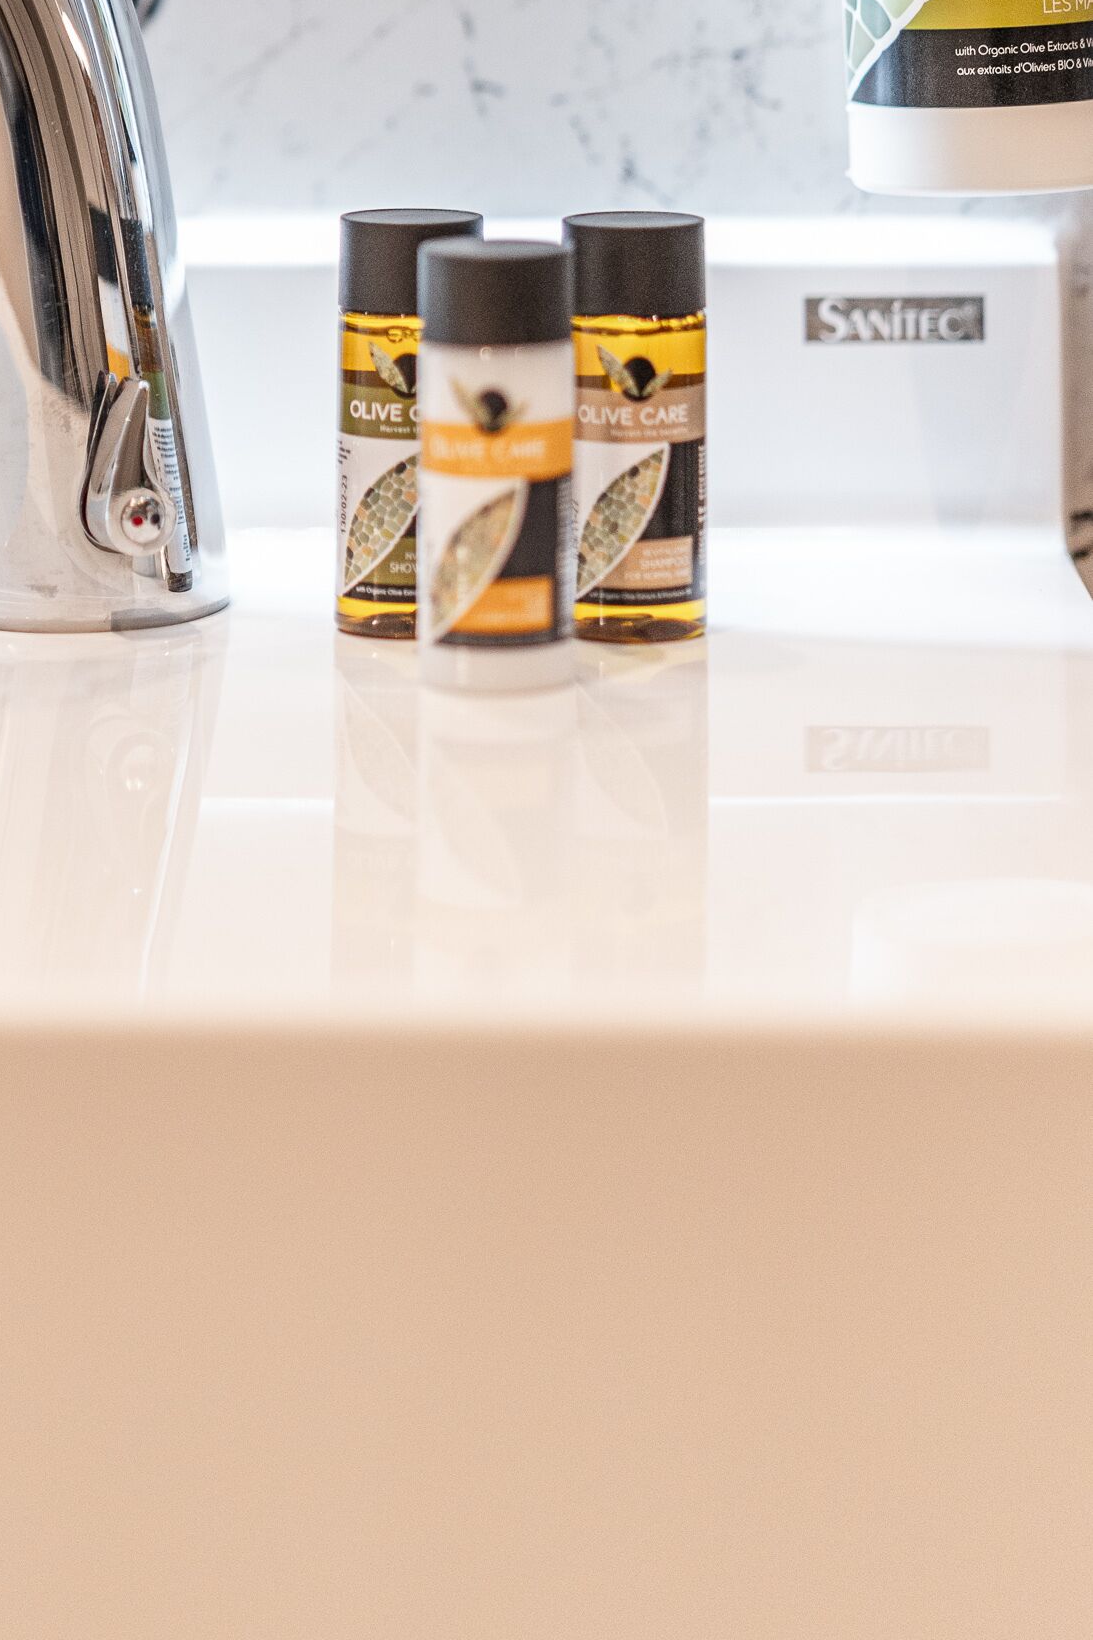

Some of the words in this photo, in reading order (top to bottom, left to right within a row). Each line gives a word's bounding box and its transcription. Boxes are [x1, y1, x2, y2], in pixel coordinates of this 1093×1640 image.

[955, 45, 976, 56] with
[978, 44, 1018, 58] Organic
[1020, 42, 1045, 54] Olive
[1047, 40, 1078, 52] Extracts
[1079, 38, 1086, 49] &
[957, 66, 976, 76] aux
[977, 64, 1012, 76] extraits
[1013, 62, 1056, 74] d'Oliviers
[1057, 59, 1074, 71] BIO
[1075, 58, 1082, 69] &
[350, 399, 403, 422] OLIVE
[578, 403, 634, 426] OLIVE
[640, 403, 688, 426] CARE
